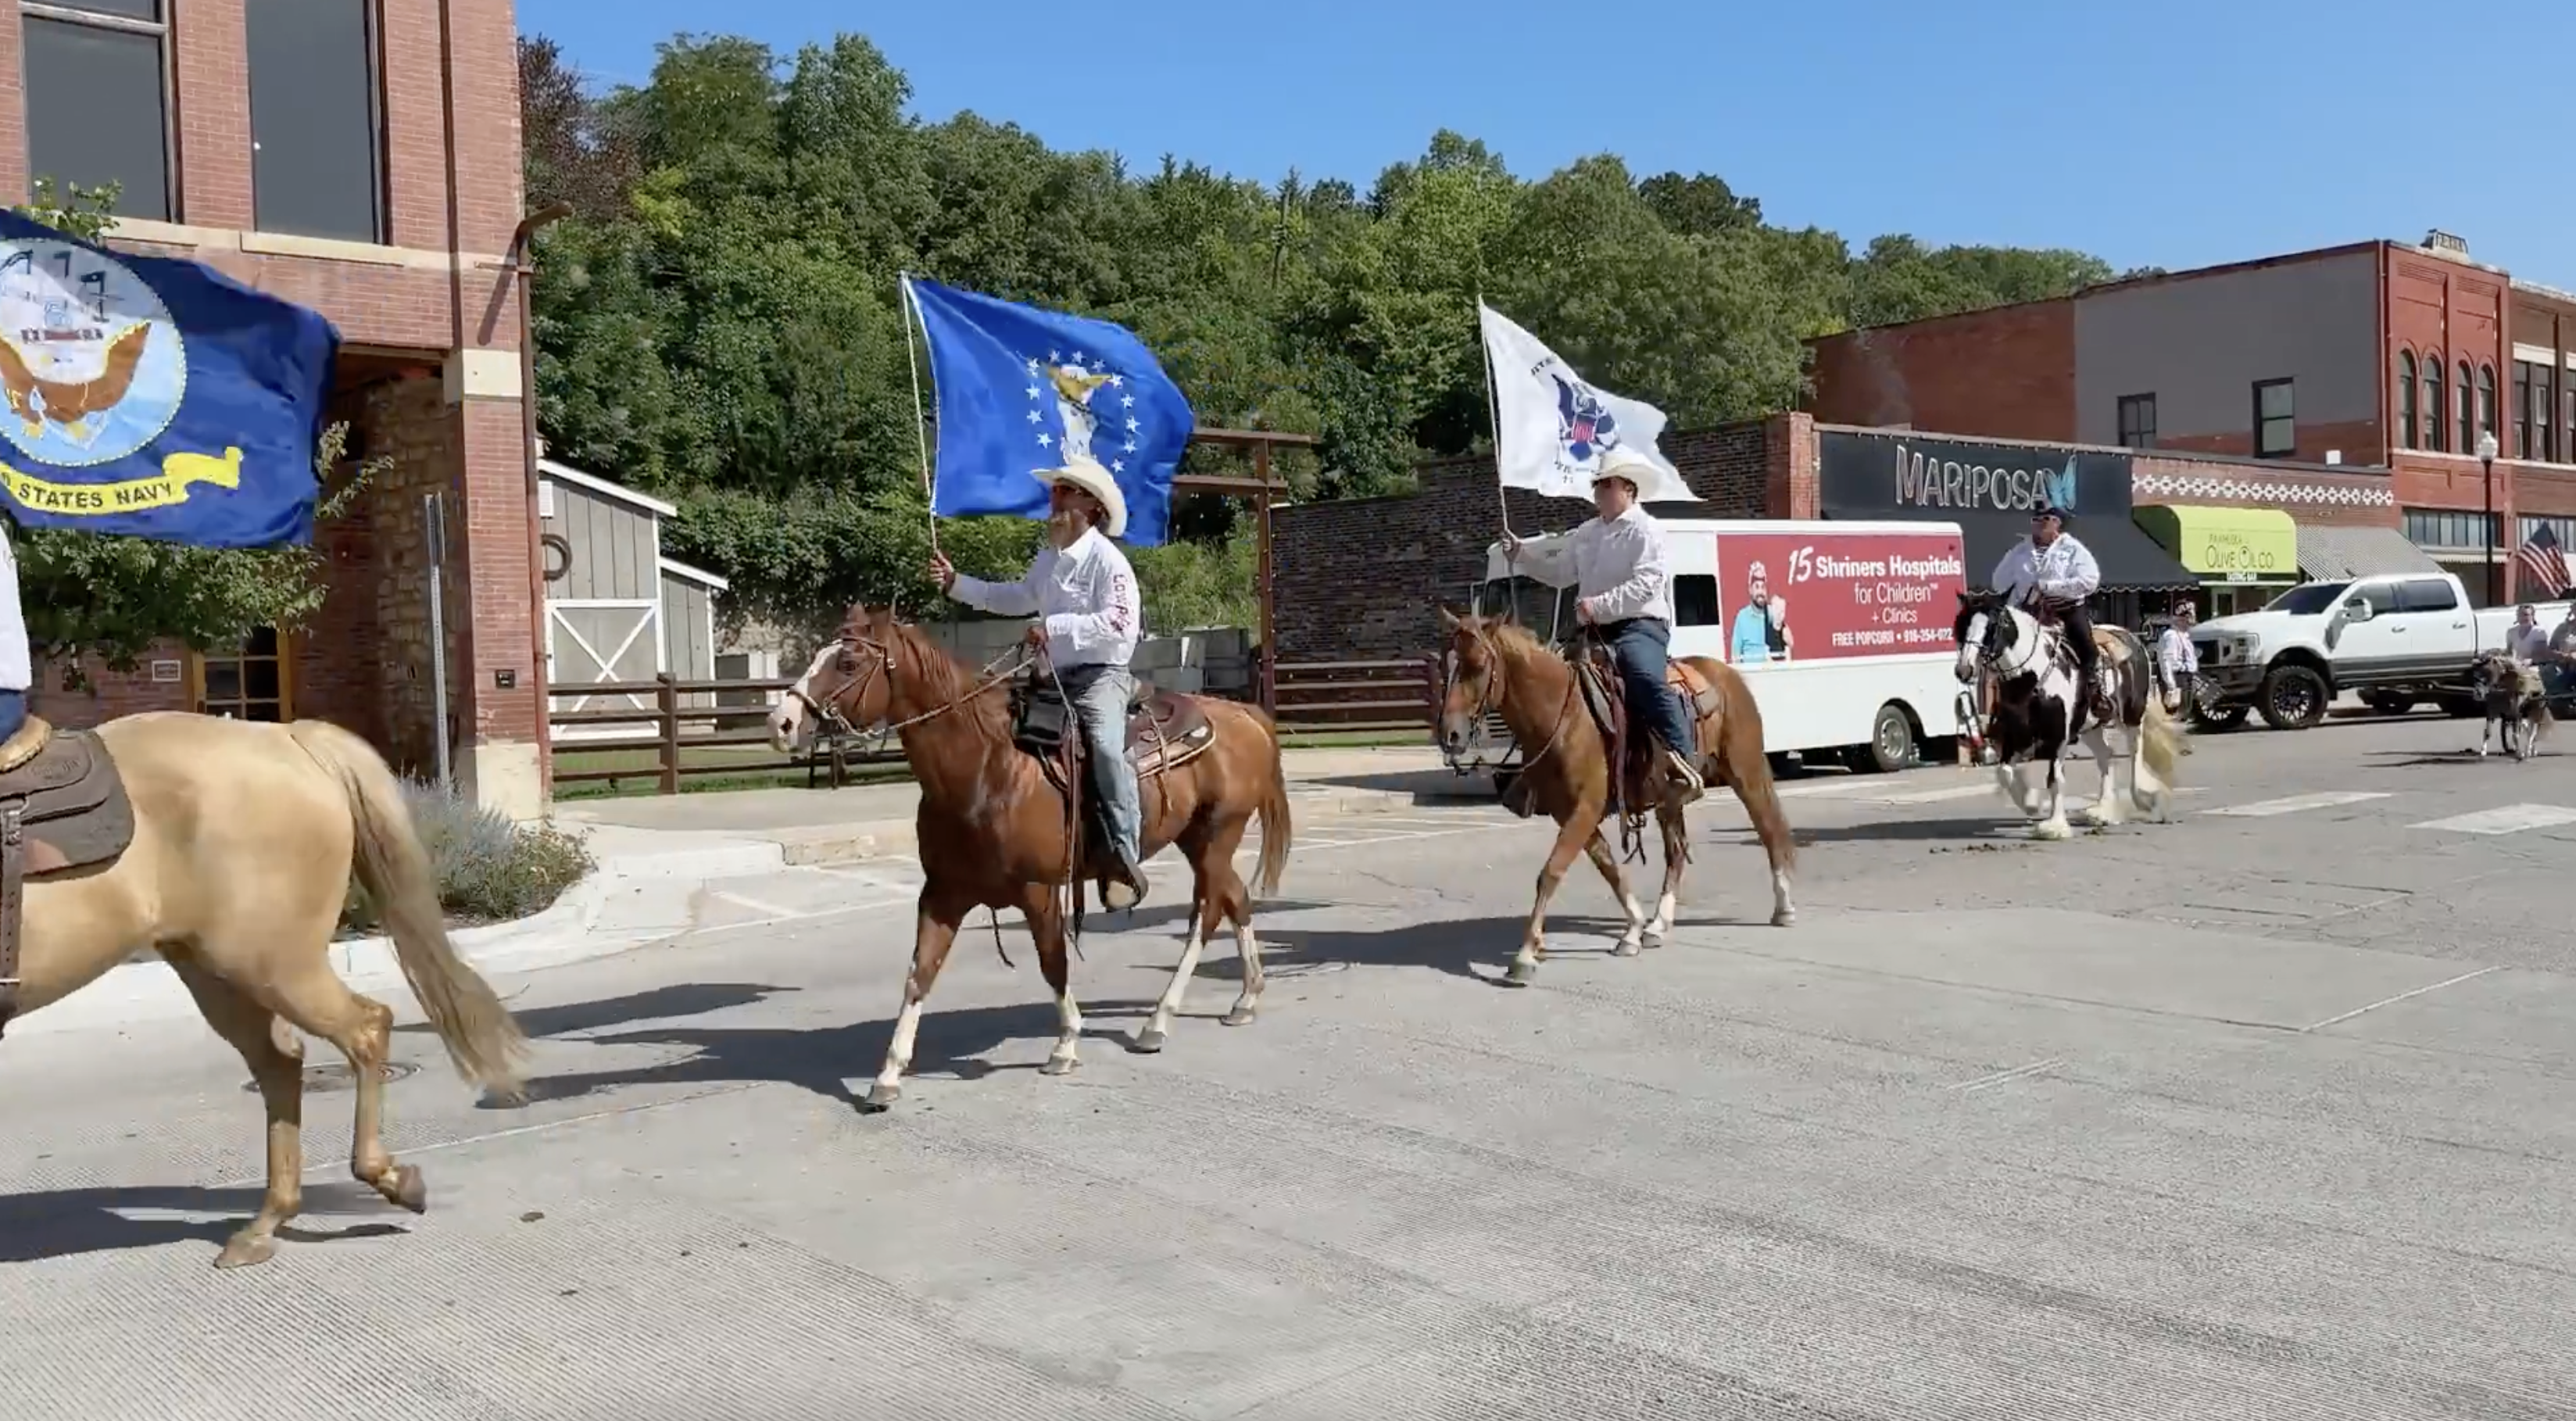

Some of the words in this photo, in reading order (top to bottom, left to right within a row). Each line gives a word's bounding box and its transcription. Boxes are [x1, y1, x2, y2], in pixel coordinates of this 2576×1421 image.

[1895, 443, 2048, 510] MARIPOSA
[18, 482, 104, 509] STATES
[115, 481, 172, 505] NAVY
[1787, 546, 1814, 585] 15
[1816, 556, 1886, 578] Shriners
[1889, 554, 1962, 581] Hospitals
[2206, 545, 2235, 568] OLIVE
[2258, 552, 2274, 569] CO
[1854, 583, 1873, 604] for
[1883, 607, 1918, 624] Clinics
[1832, 632, 1855, 647] FREE
[1855, 629, 1894, 646] POPCORN
